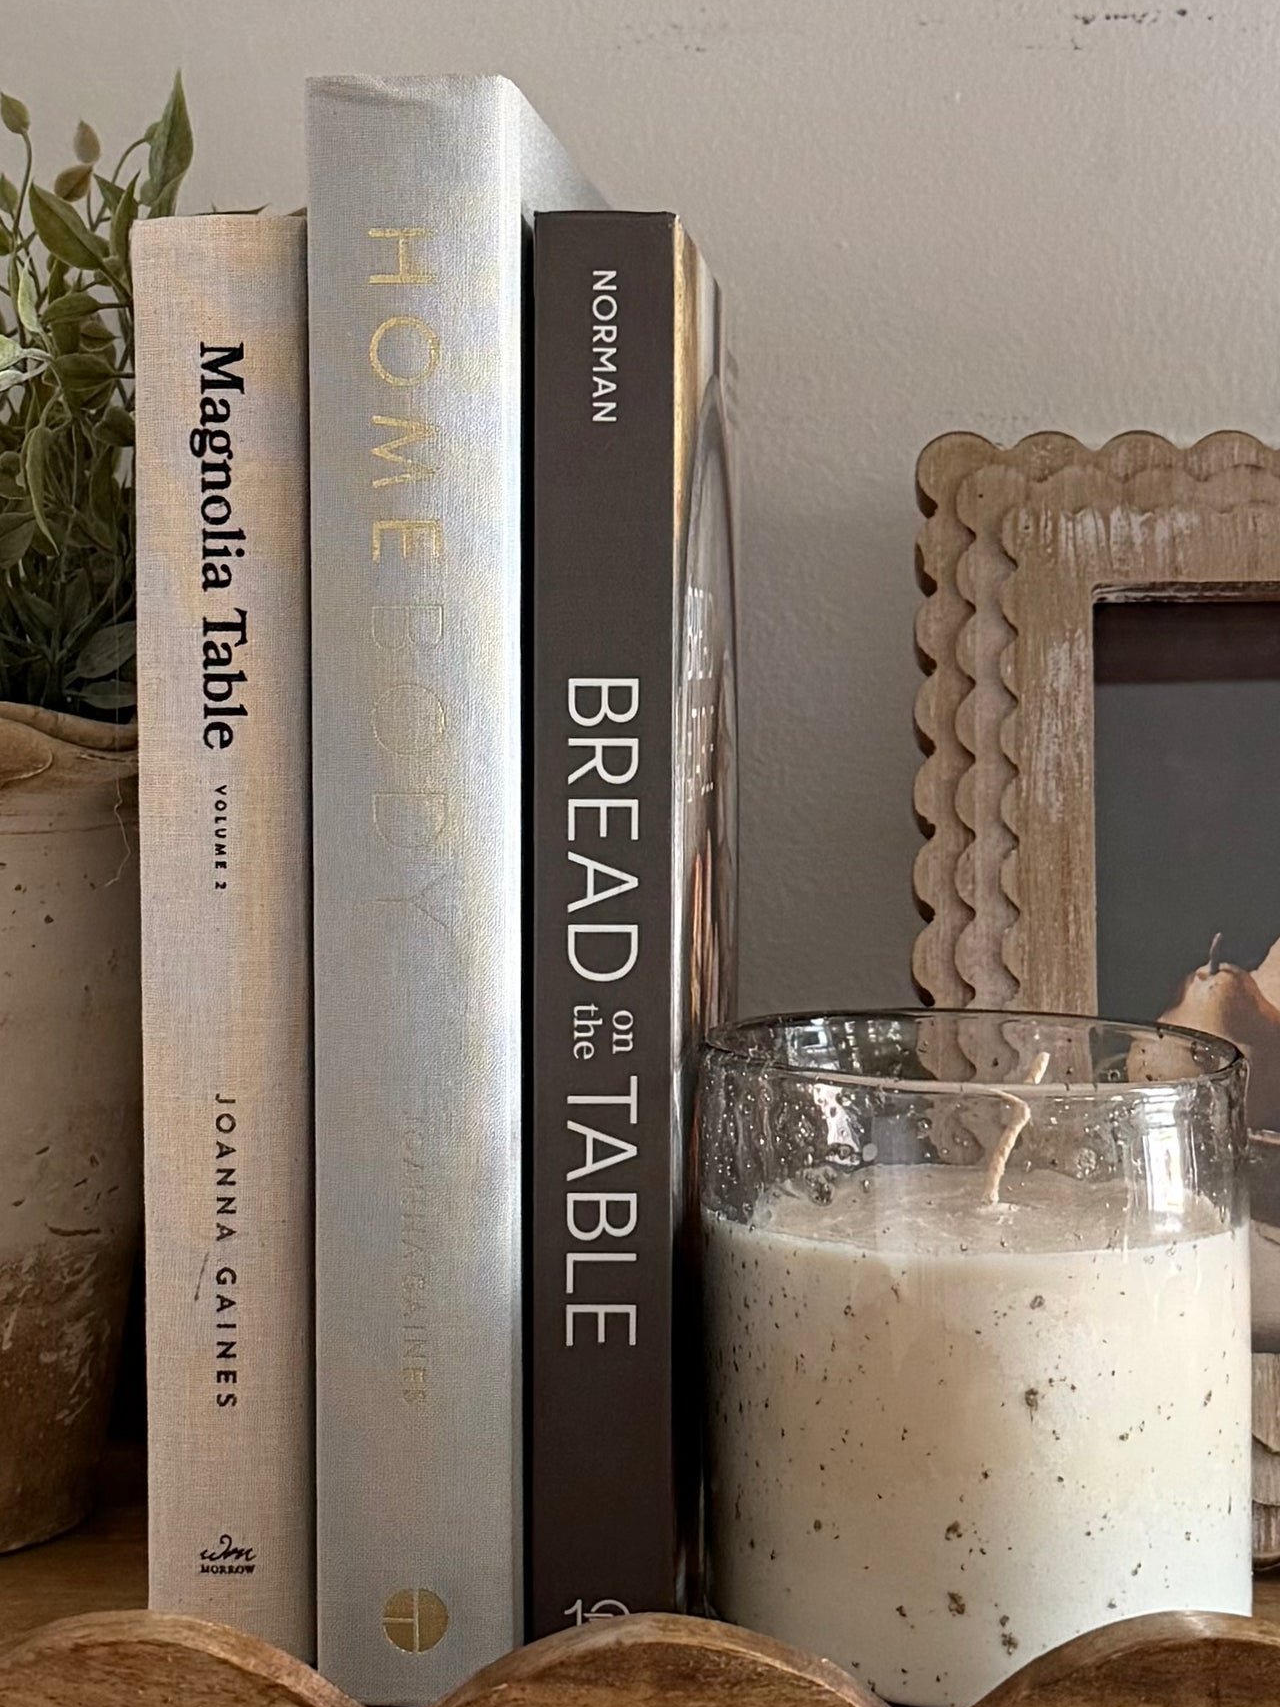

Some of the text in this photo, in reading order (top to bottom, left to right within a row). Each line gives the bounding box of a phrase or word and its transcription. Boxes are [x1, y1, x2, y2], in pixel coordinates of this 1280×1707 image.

[592, 270, 618, 422] NORMAN
[189, 341, 249, 751] Magnolia Table
[214, 784, 228, 891] VOLUME 2
[565, 677, 640, 1347] BREAD on the TABLE
[214, 1093, 238, 1408] JOANNA GAINES
[200, 1564, 256, 1575] MORROW
